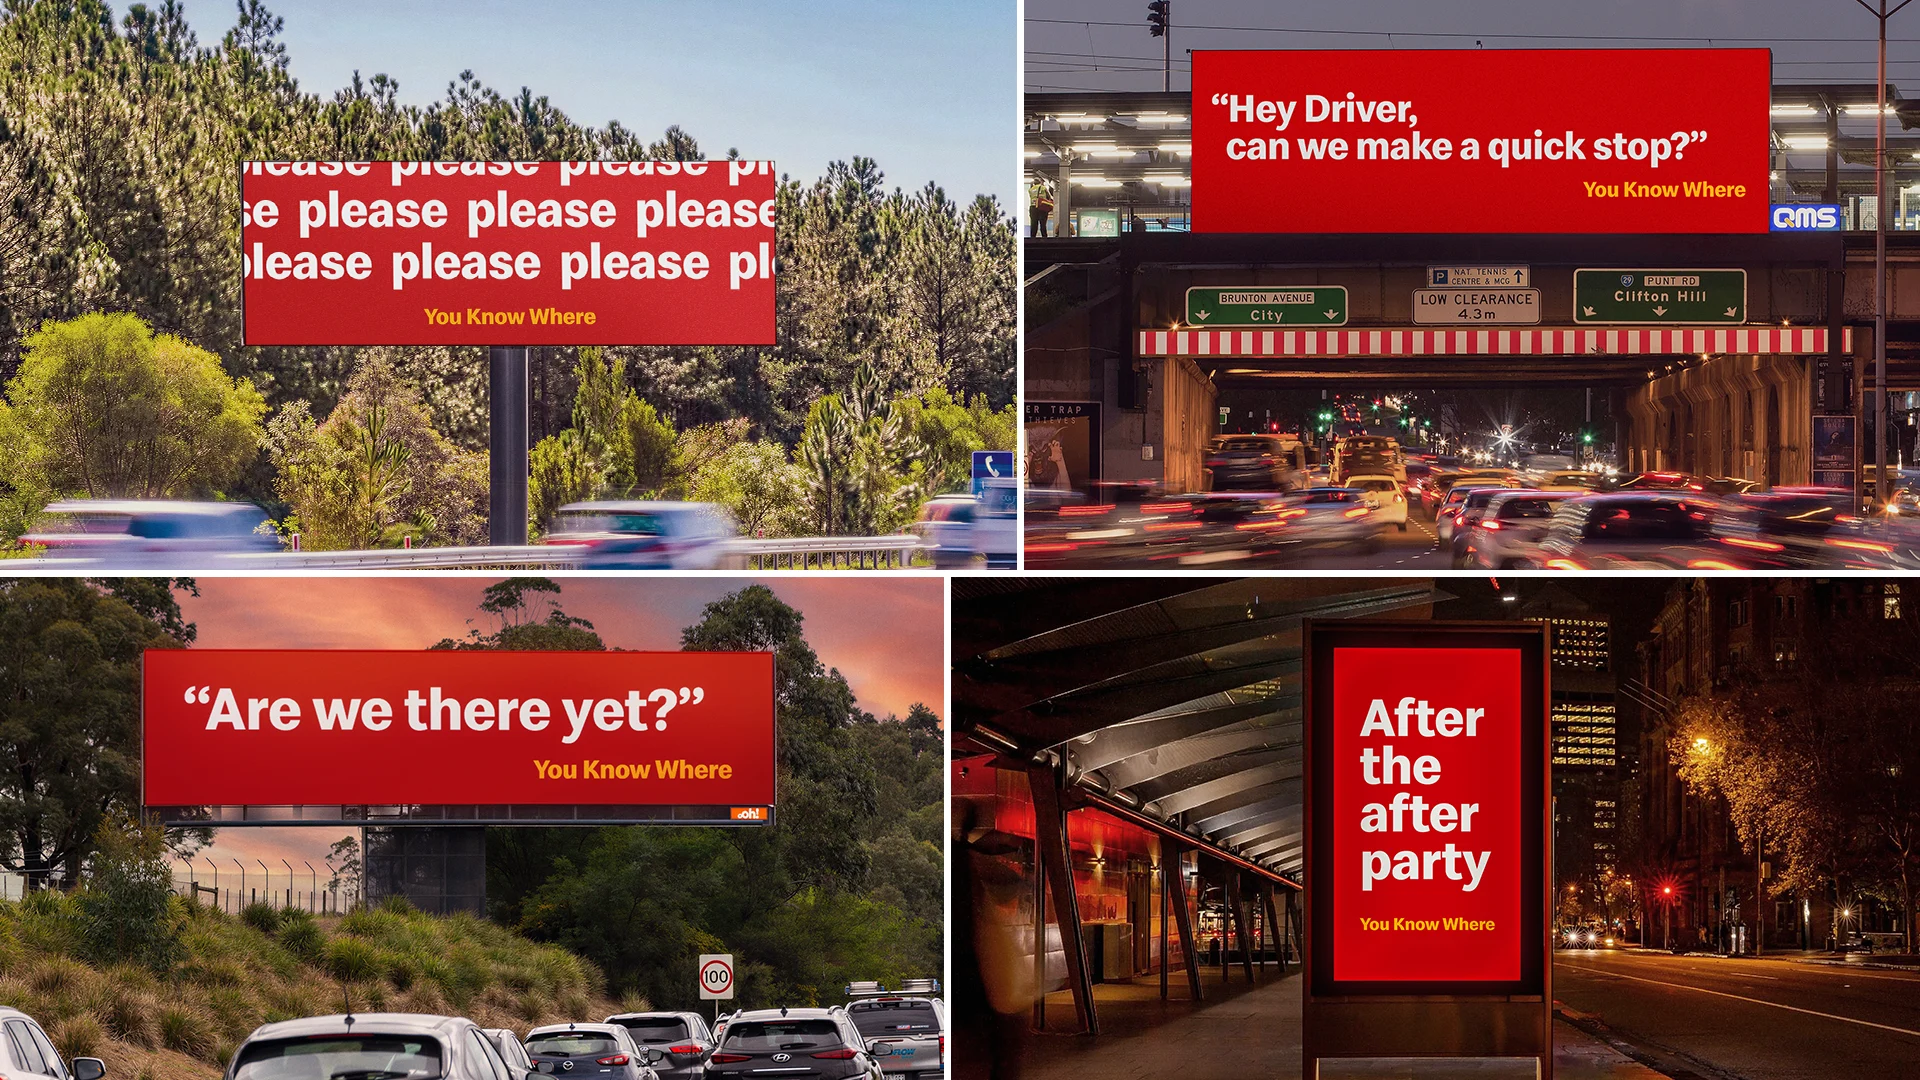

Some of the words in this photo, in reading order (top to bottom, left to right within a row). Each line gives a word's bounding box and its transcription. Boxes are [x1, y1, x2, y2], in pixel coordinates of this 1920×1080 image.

[1212, 93, 1297, 131] “Hey
[1305, 92, 1418, 128] Driver,
[1226, 138, 1289, 160] can
[1297, 138, 1349, 160] we
[1357, 131, 1453, 160] make
[1460, 138, 1480, 160] a
[1488, 130, 1587, 168] quick
[1594, 131, 1708, 168] stop?”
[1584, 182, 1619, 198] You
[1625, 182, 1680, 198] Know
[1682, 181, 1746, 198] Where
[299, 189, 449, 239] please
[467, 189, 617, 239] please
[1773, 207, 1837, 228] QMS
[244, 242, 373, 281] lease
[392, 242, 541, 291] please
[561, 242, 710, 291] please
[1454, 268, 1472, 276] NAT.
[1477, 268, 1507, 276] TENNIS
[1451, 277, 1481, 285] CENTRE
[1494, 277, 1510, 285] MCG
[1647, 277, 1676, 285] PUNT
[1682, 277, 1697, 285] RD
[1221, 294, 1267, 303] BRUNTON
[1272, 293, 1312, 302] AVENUE
[1420, 294, 1447, 305] LOW
[1454, 293, 1533, 305] CLEARANCE
[1614, 290, 1669, 302] Clifton
[1677, 290, 1706, 302] Hill
[424, 308, 462, 325] You
[467, 308, 525, 325] Know
[529, 308, 597, 325] Where
[1250, 309, 1283, 323] City
[1050, 405, 1082, 414] TRAP
[1028, 416, 1076, 425] THIEVES
[184, 686, 302, 731] “Are
[312, 697, 393, 732] we
[404, 687, 551, 732] there
[561, 686, 705, 744] yet?”
[1360, 696, 1485, 738] After
[534, 760, 577, 779] You
[584, 760, 651, 779] Know
[656, 760, 732, 779] Where
[1360, 744, 1442, 785] the
[1360, 791, 1480, 833] after
[1362, 844, 1492, 892] party
[1360, 917, 1390, 931] You
[1394, 917, 1440, 931] Know
[1443, 917, 1495, 931] Where
[704, 970, 729, 984] 100
